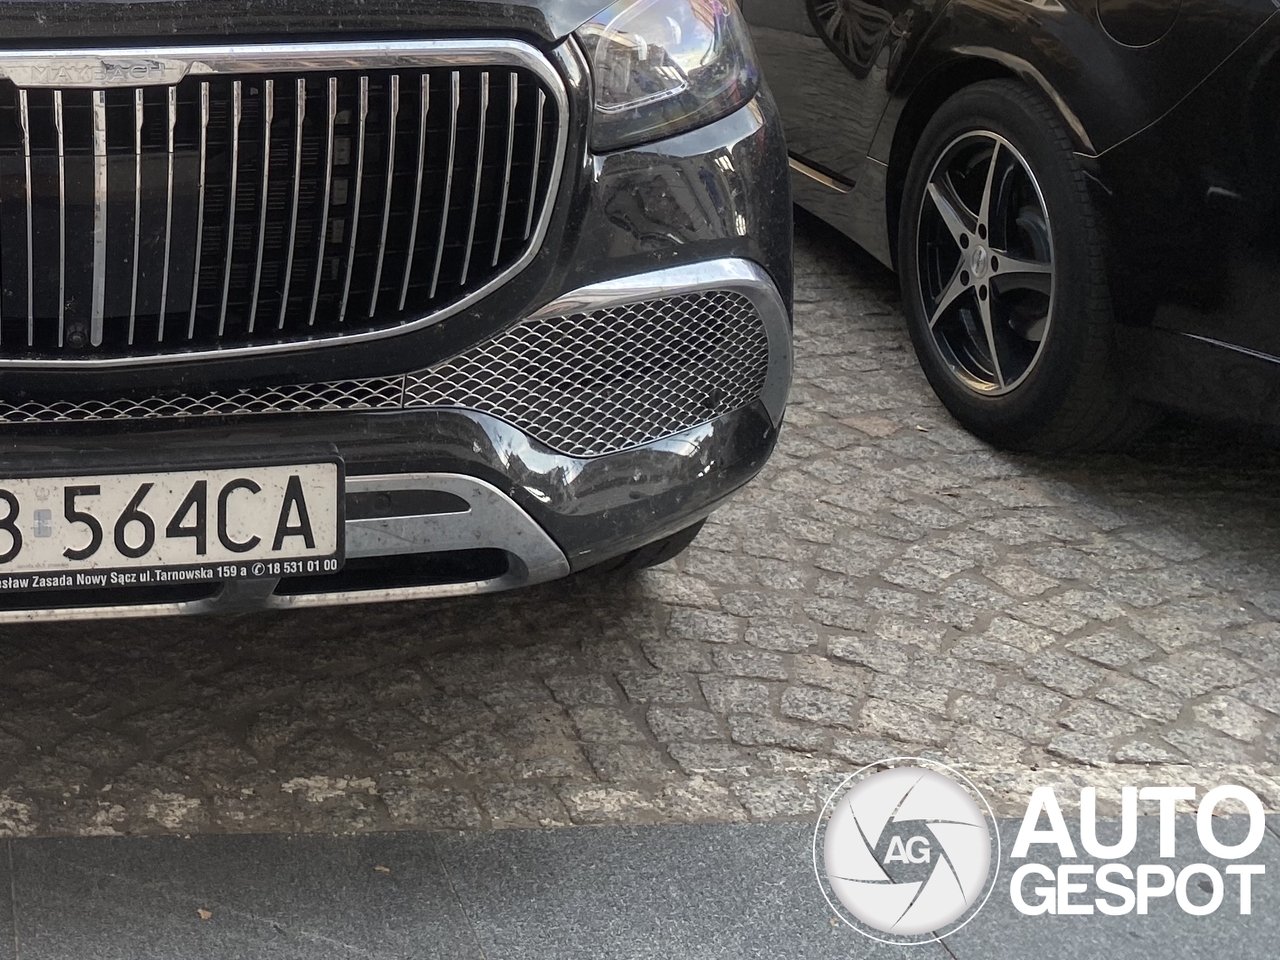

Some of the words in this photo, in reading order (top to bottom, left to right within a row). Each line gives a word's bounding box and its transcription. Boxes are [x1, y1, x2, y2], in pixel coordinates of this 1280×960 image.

[31, 64, 166, 82] MAYBACH
[62, 475, 316, 561] 564CA
[32, 574, 73, 588] Zasada
[76, 573, 107, 586] Nowy
[110, 571, 137, 585] Sącz
[217, 565, 237, 578] 159
[240, 567, 247, 577] a
[267, 563, 281, 575] 18
[283, 562, 303, 574] 531
[307, 560, 320, 572] 01
[323, 559, 338, 571] 00
